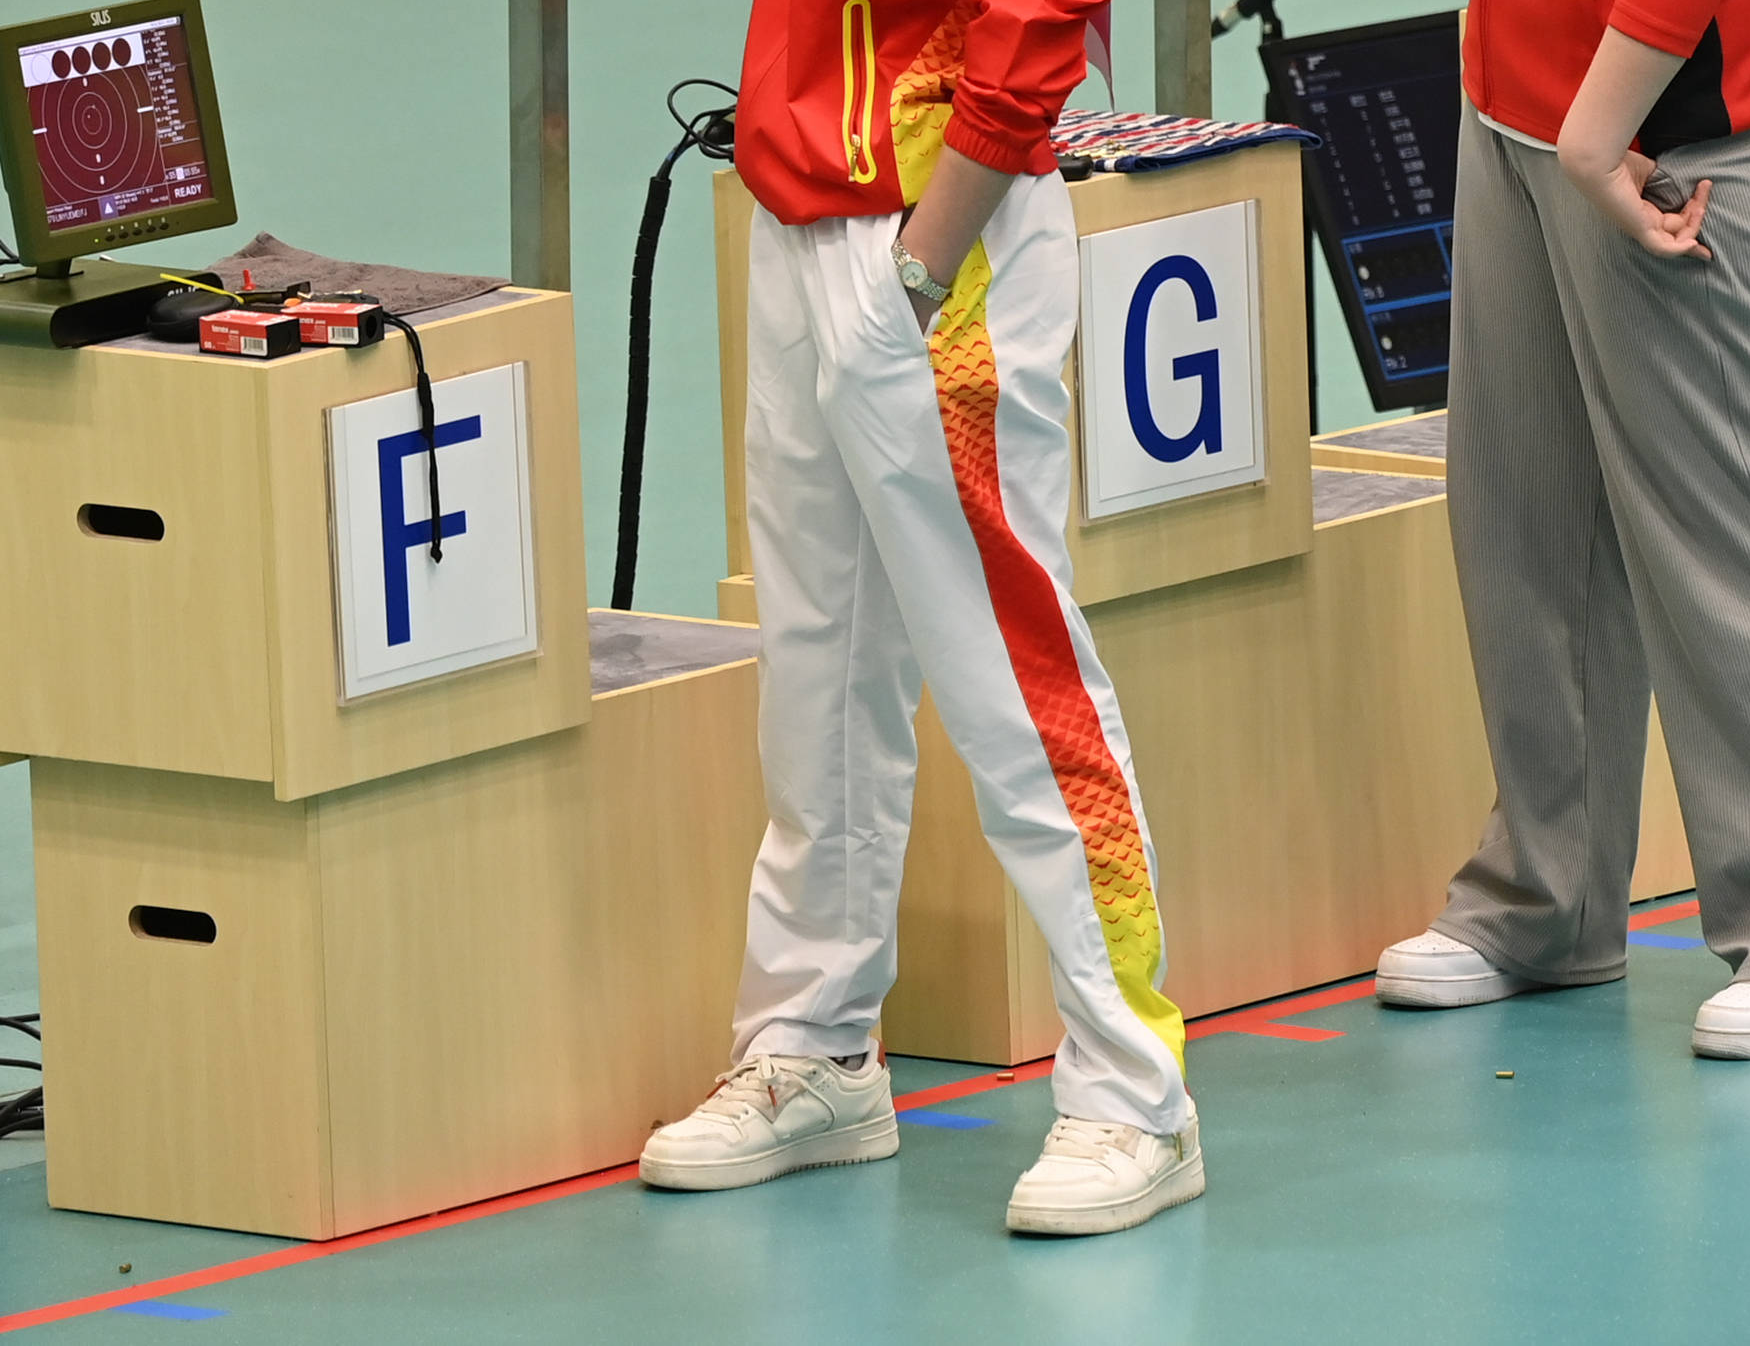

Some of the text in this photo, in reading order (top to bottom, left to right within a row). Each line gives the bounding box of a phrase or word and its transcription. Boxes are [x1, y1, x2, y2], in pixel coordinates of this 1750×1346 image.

[91, 10, 111, 26] SIUS
[174, 184, 202, 198] READY
[1124, 255, 1222, 463] G
[378, 415, 481, 647] F
